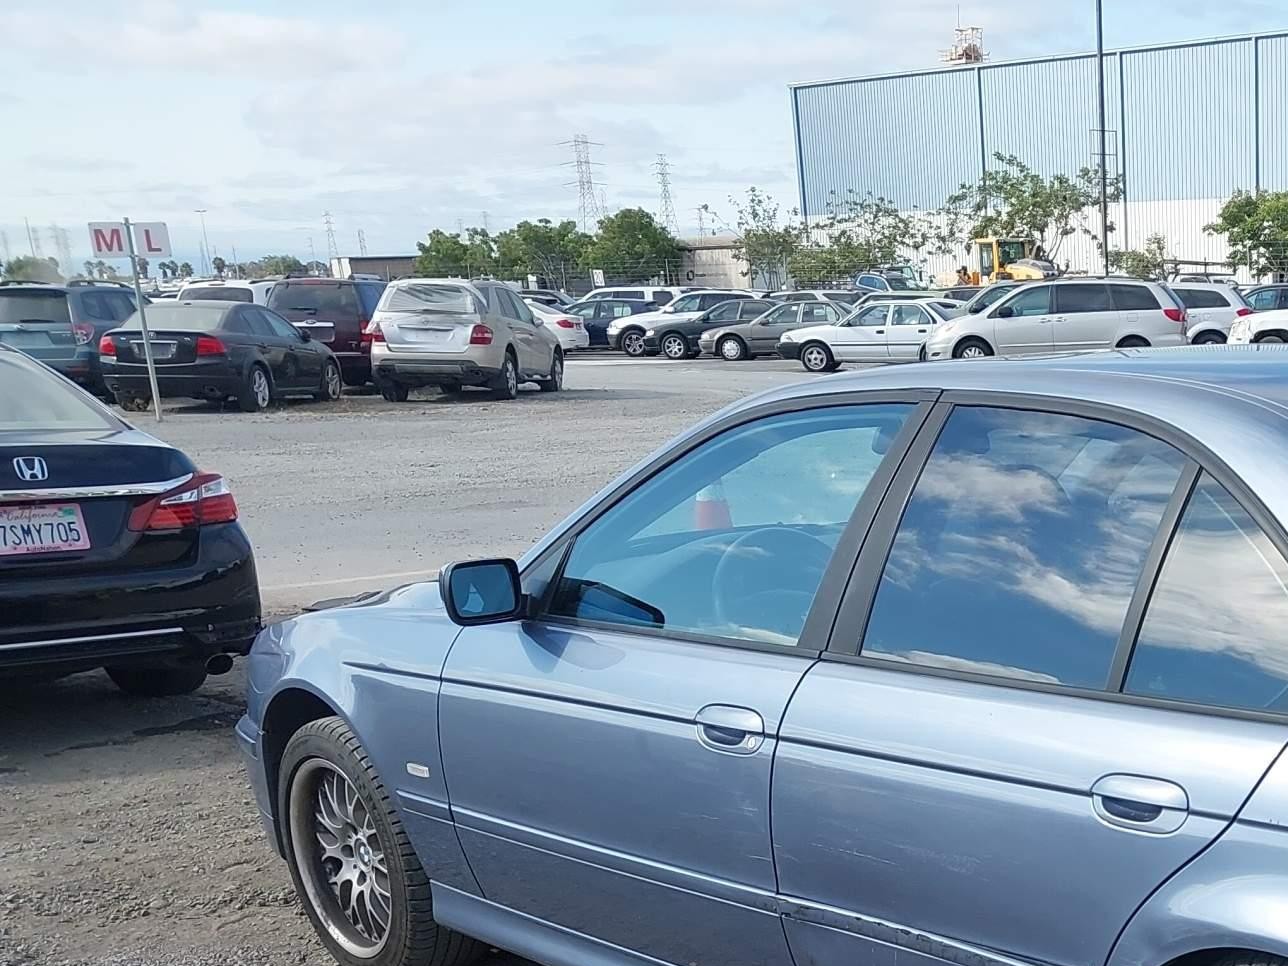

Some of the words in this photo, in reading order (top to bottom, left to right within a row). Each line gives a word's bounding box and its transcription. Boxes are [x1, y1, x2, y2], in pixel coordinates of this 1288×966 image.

[93, 228, 124, 252] M
[143, 228, 162, 252] L
[0, 521, 81, 546] 7SMY705
